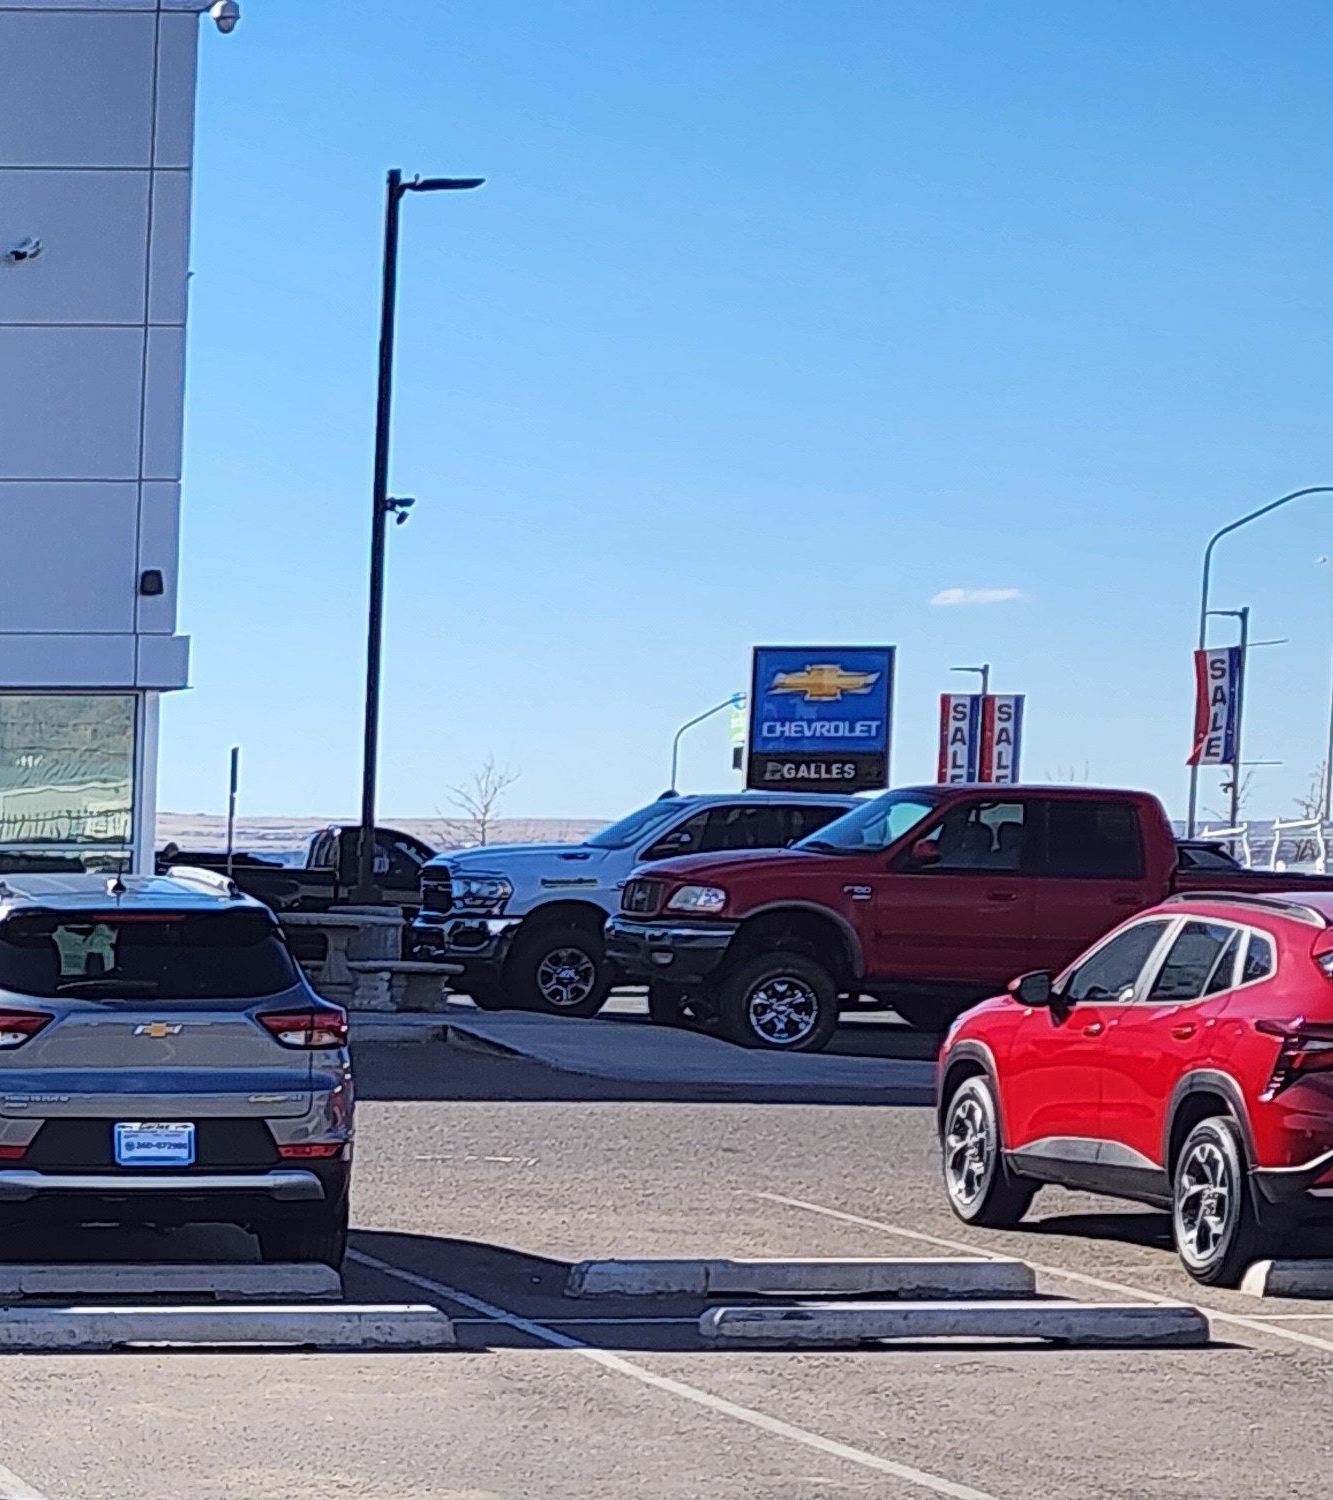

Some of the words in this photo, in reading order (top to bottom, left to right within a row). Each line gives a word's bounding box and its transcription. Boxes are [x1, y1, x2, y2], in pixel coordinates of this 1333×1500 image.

[1204, 658, 1227, 758] SALE
[761, 720, 882, 738] CHEVROLET
[782, 762, 856, 780] GALLES
